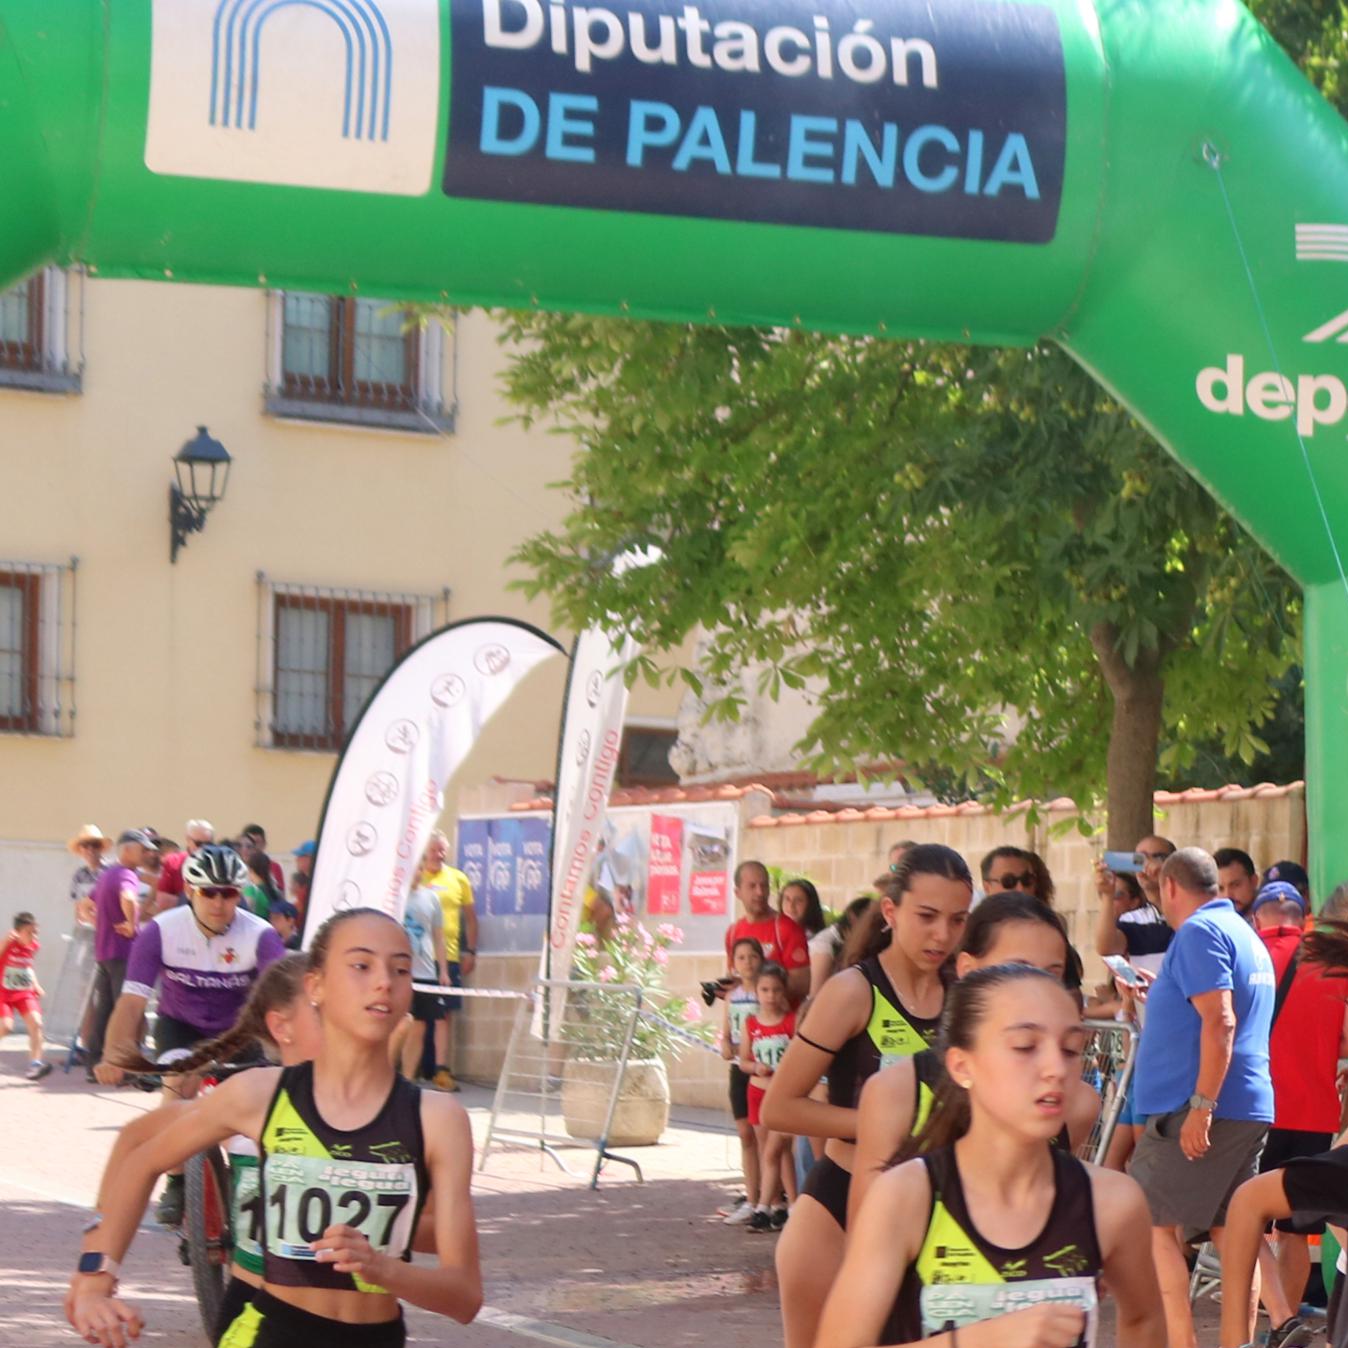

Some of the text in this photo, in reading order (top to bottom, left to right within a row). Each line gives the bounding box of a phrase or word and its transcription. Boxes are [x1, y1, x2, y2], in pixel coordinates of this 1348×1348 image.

[481, 0, 938, 88] Diputación
[479, 86, 1042, 200] DE PALENCIA
[584, 729, 619, 822] Contigo
[551, 830, 592, 951] Contamos
[270, 1183, 412, 1247] 1027
